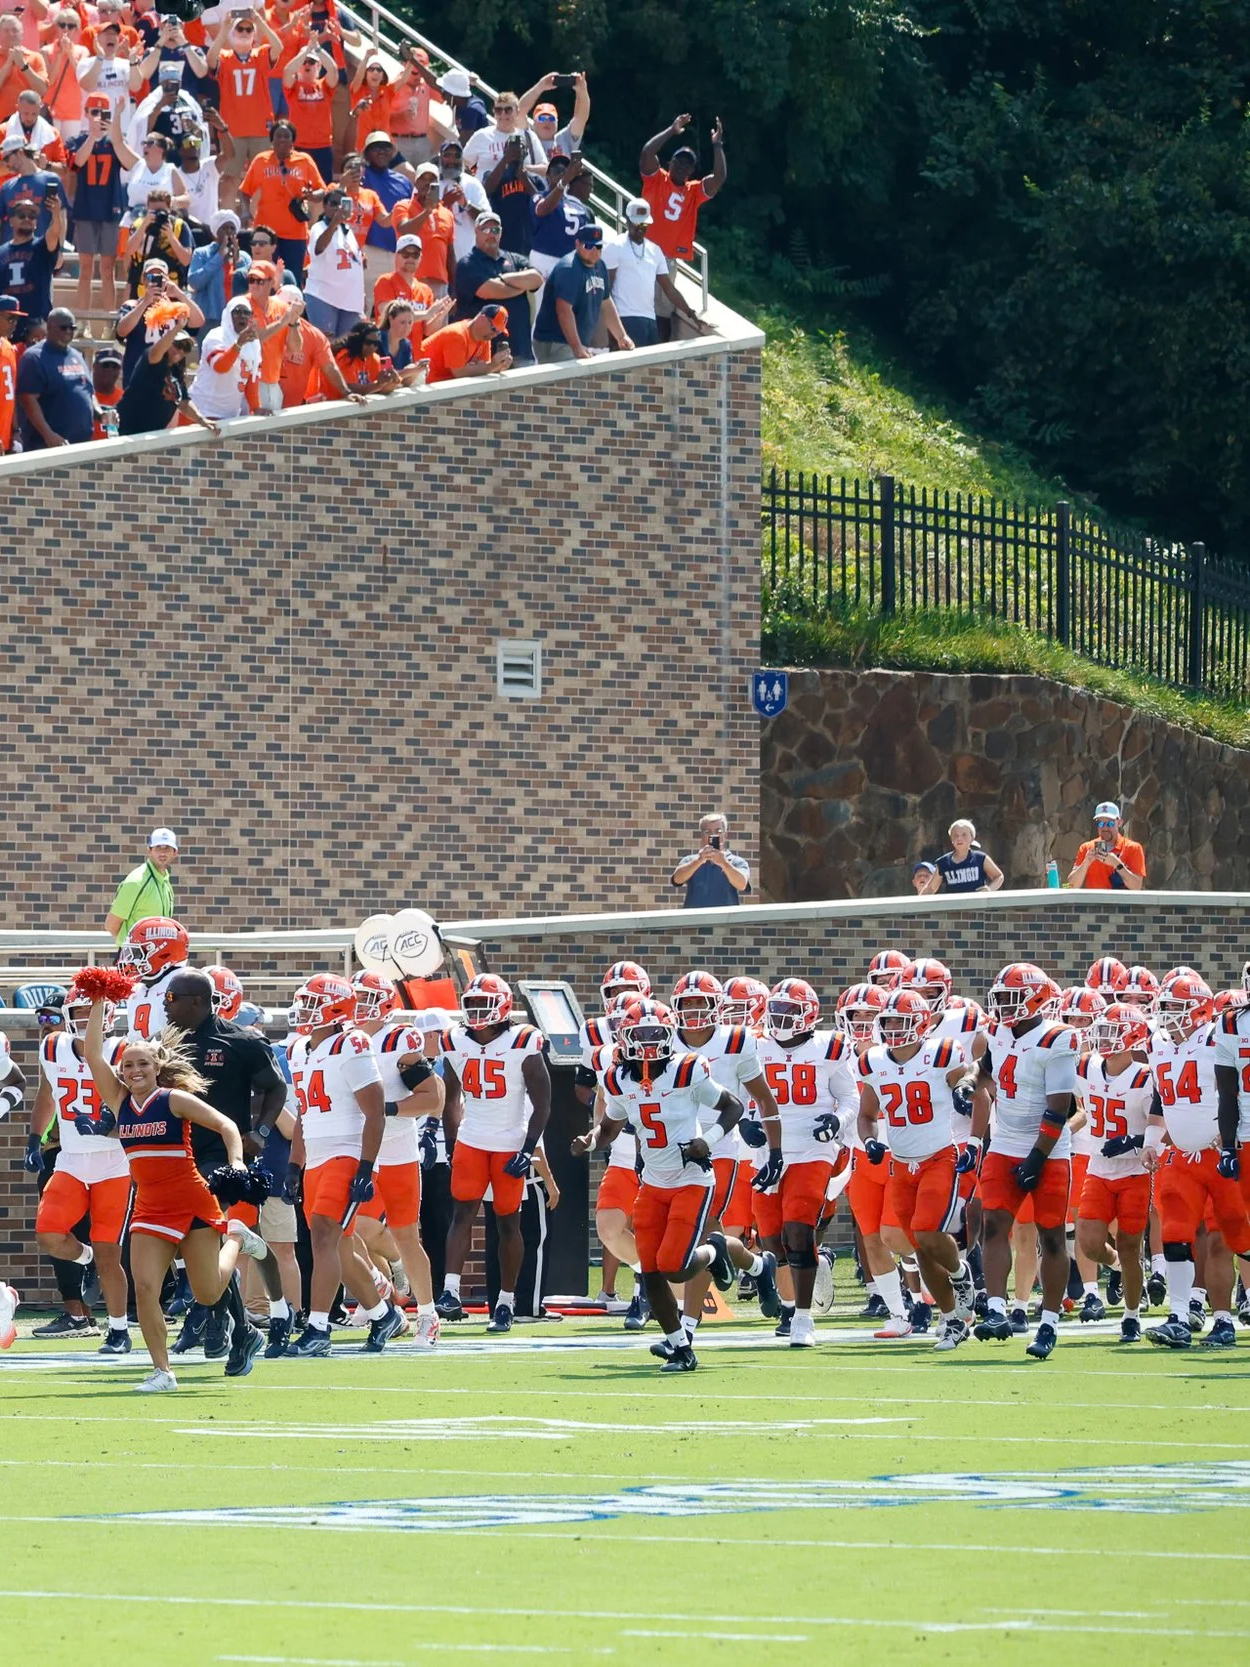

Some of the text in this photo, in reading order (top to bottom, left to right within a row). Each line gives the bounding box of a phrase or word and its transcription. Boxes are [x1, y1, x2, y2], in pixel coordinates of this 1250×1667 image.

[232, 68, 257, 96] 17
[87, 154, 112, 186] 17
[663, 191, 685, 222] 5
[400, 937, 423, 952] ACC
[134, 1003, 151, 1040] 9
[292, 1069, 333, 1116] 54
[462, 1058, 507, 1099] 45
[764, 1063, 818, 1106] 58
[998, 1053, 1018, 1100] 4
[57, 1076, 101, 1122] 23
[880, 1080, 935, 1128] 28
[1089, 1093, 1129, 1140] 35
[119, 1121, 167, 1139] LLINOIS
[638, 1102, 669, 1149] 5
